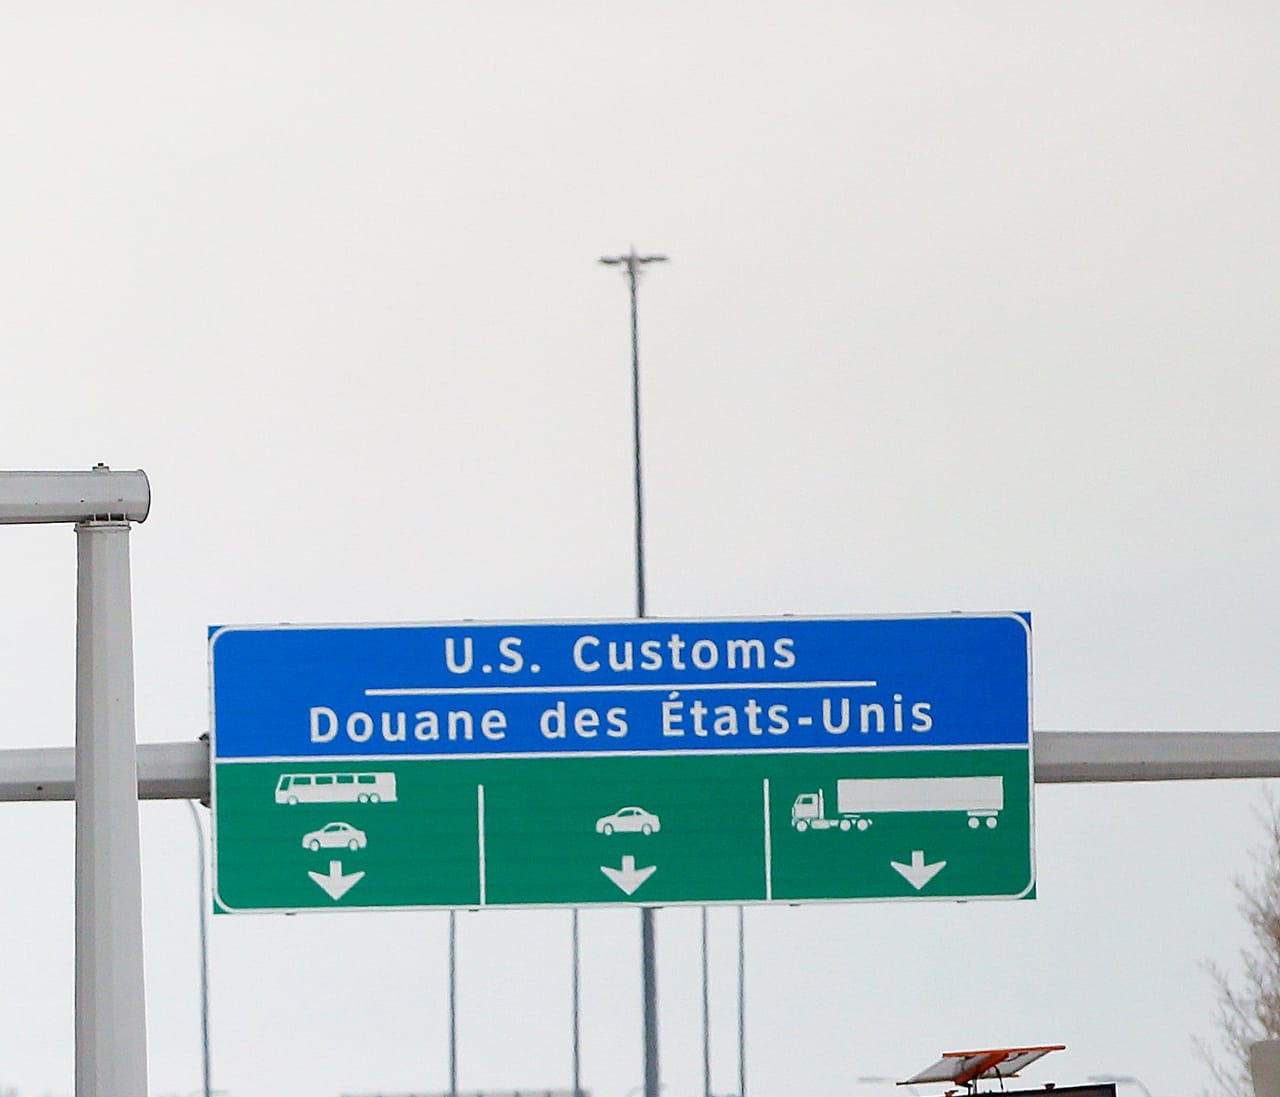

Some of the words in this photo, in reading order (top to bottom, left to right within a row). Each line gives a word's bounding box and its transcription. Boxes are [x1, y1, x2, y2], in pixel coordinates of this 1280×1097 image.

[445, 637, 541, 674] U.S.
[572, 634, 797, 673] Customs
[310, 706, 508, 743] Douane
[540, 701, 629, 739] des
[662, 691, 933, 737] États-Unis
